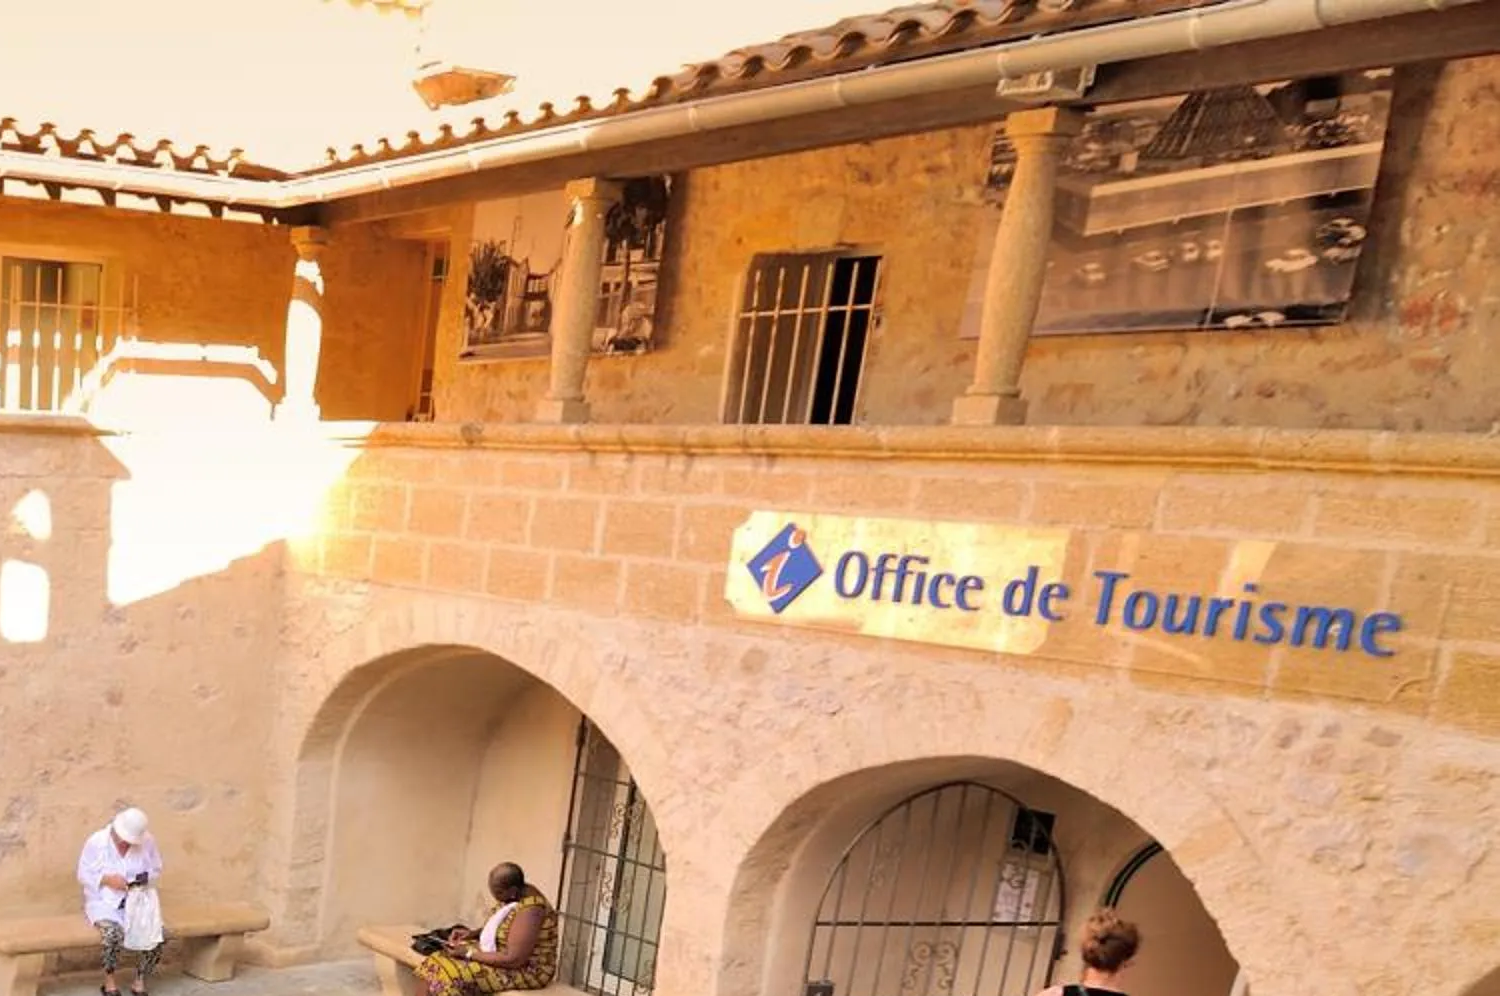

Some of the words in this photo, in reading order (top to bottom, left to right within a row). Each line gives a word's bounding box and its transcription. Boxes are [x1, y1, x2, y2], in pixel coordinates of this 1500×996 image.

[834, 550, 984, 611] Office
[1002, 565, 1070, 622] de
[1093, 569, 1403, 658] Tourisme
